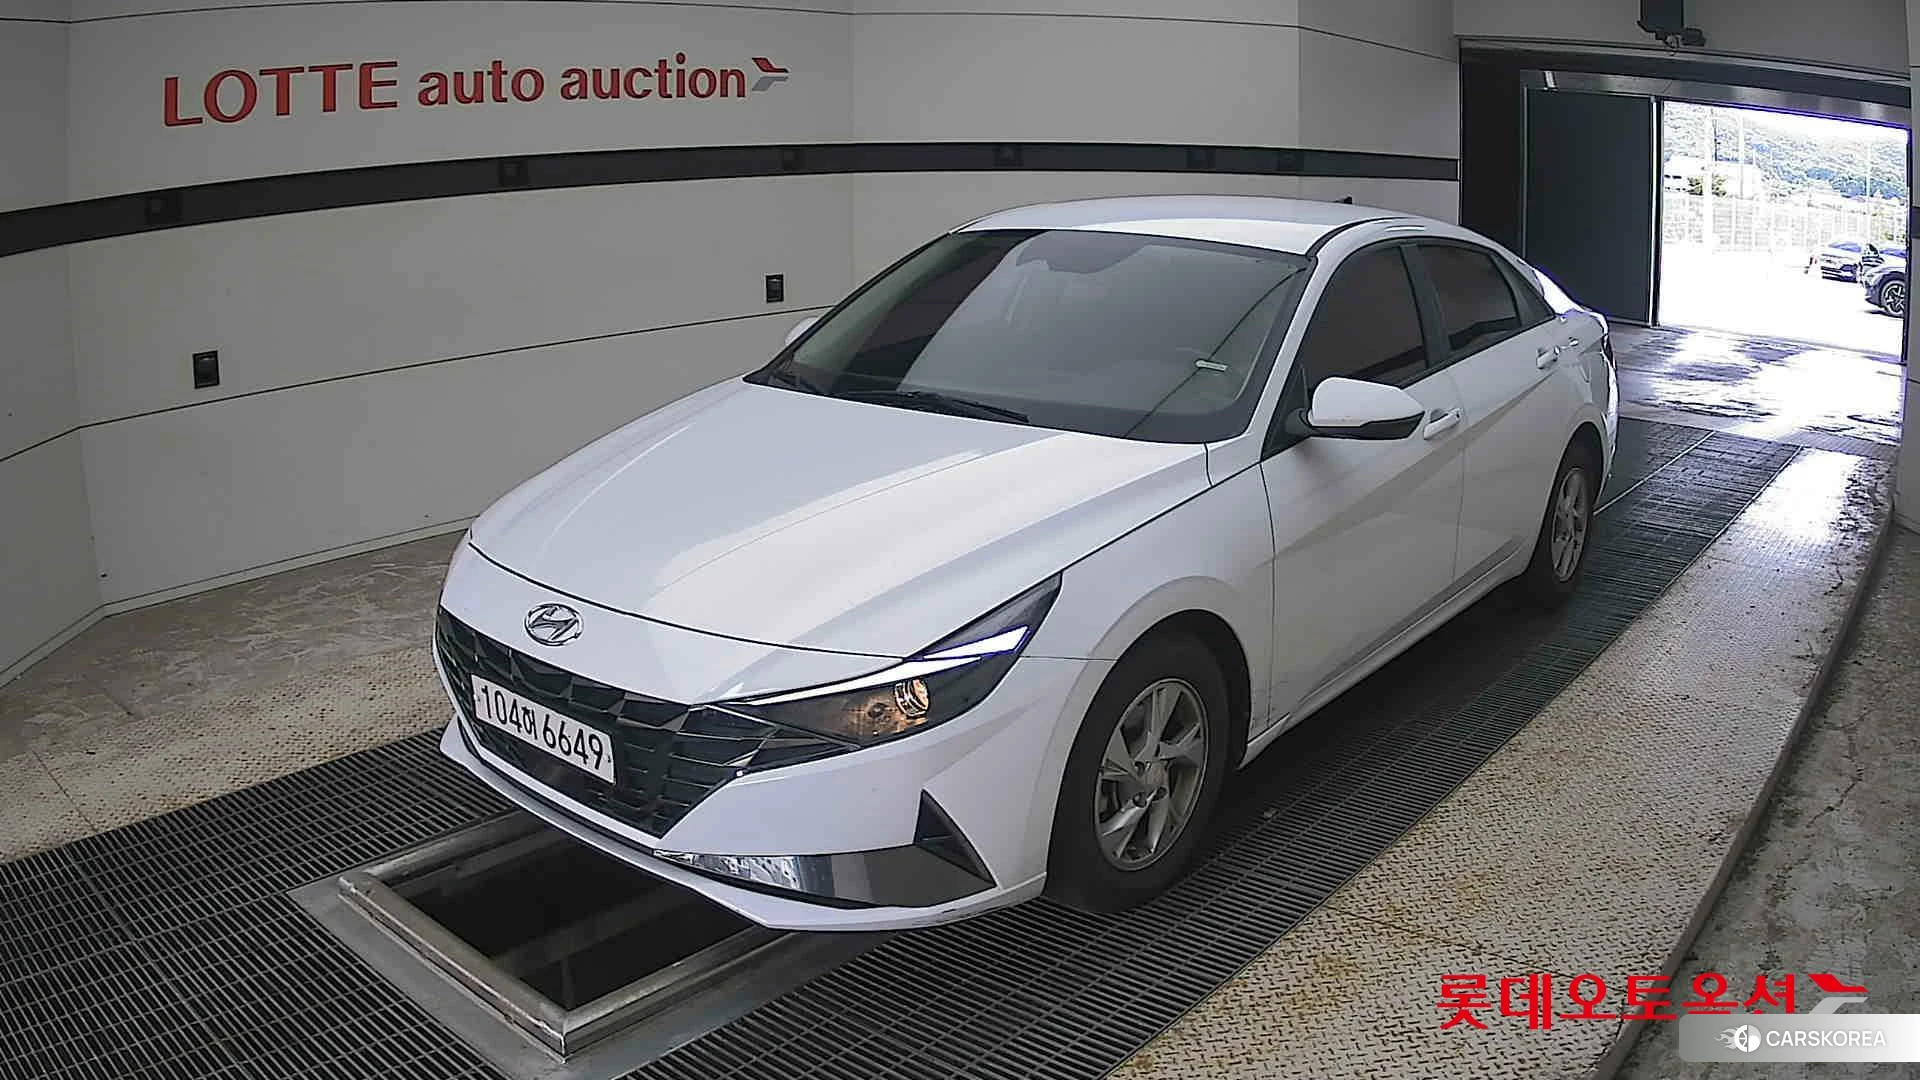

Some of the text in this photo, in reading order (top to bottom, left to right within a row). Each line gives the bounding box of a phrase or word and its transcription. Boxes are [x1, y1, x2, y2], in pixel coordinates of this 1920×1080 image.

[163, 52, 747, 127] LOTTE auto auction
